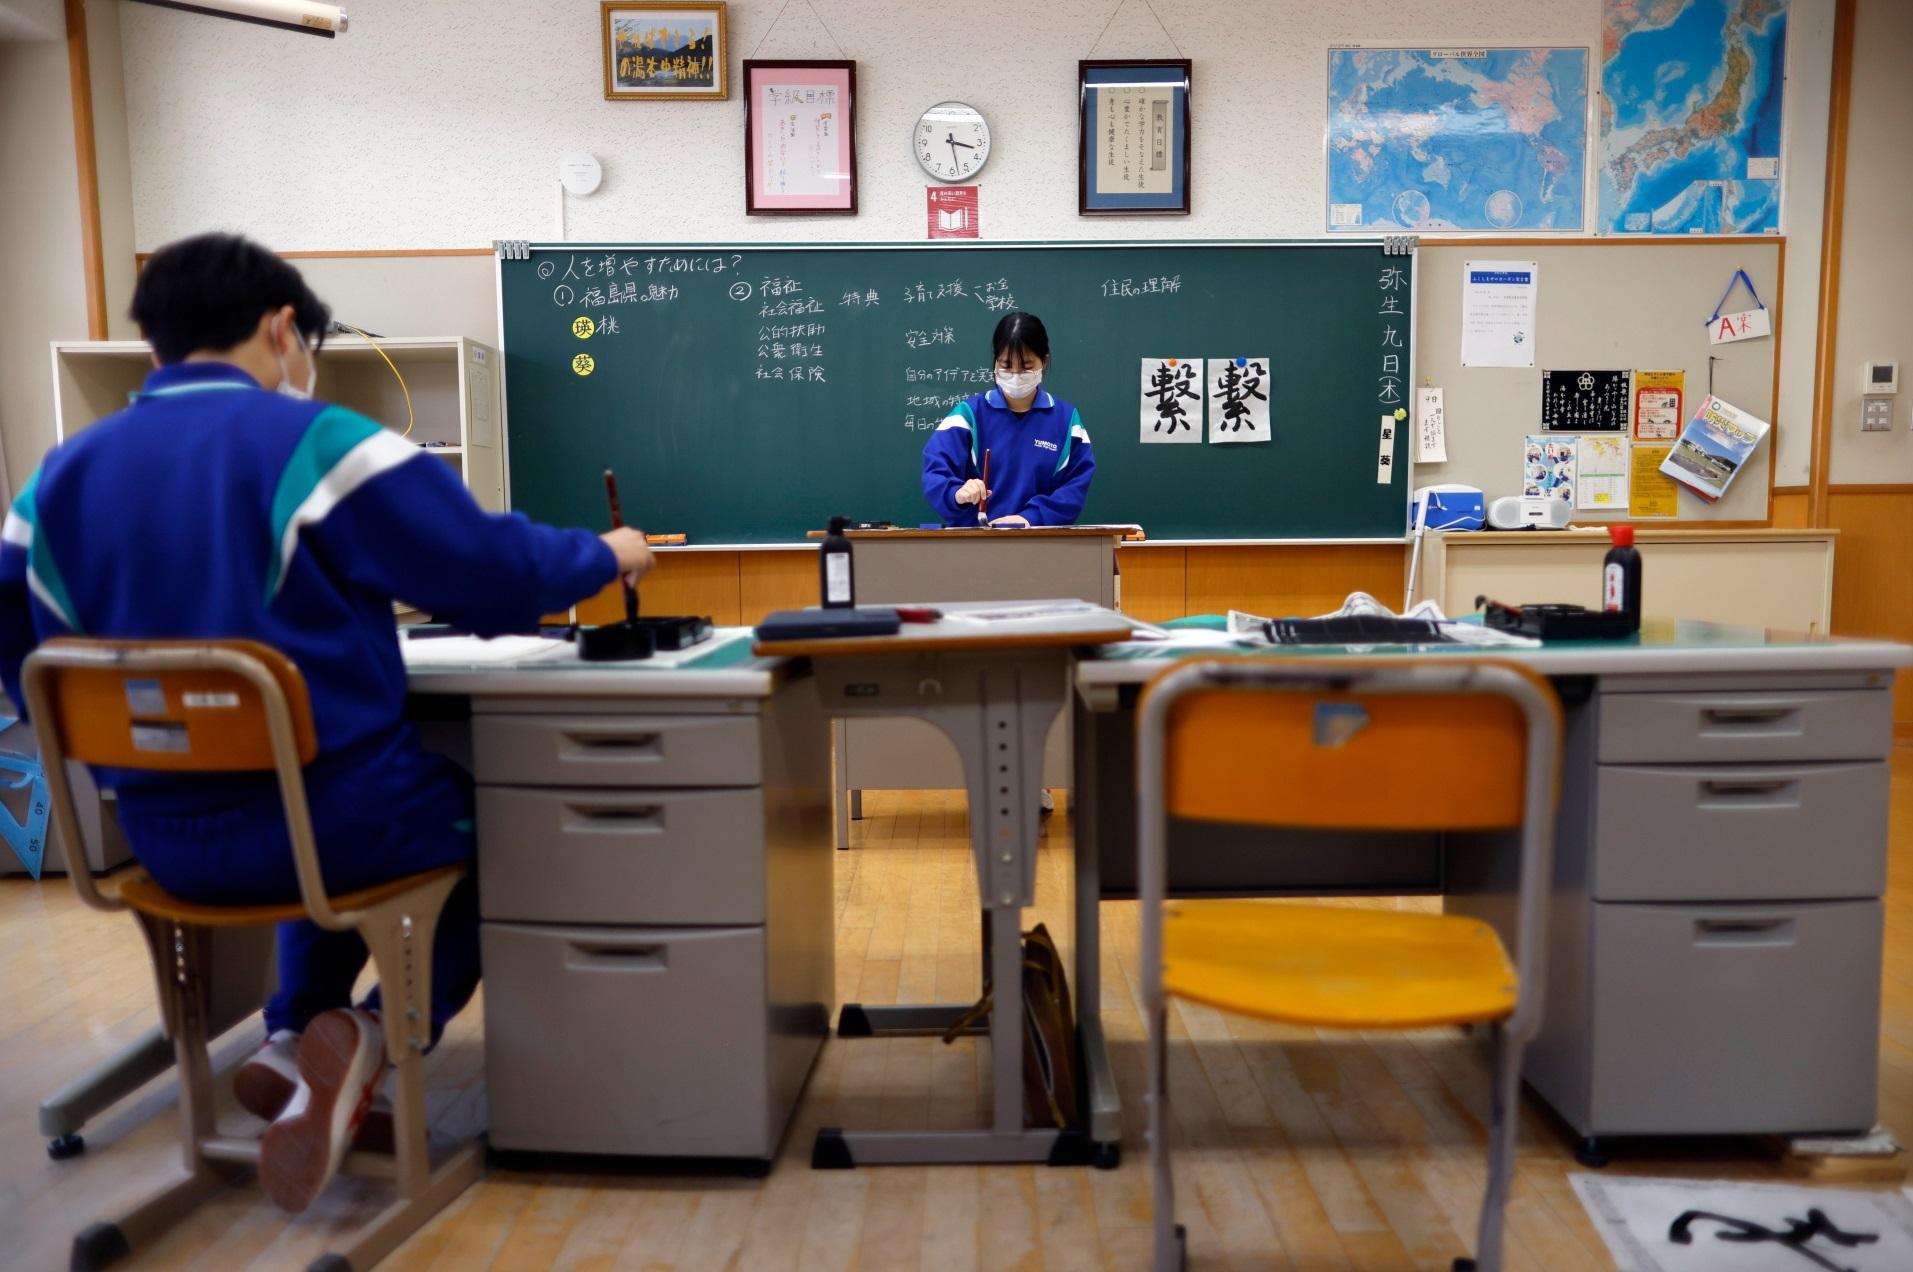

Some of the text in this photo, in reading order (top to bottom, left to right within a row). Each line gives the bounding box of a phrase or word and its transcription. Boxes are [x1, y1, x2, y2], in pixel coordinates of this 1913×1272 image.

[769, 88, 835, 106] 学級目標
[925, 125, 932, 133] 10
[922, 139, 927, 147] 9
[925, 153, 931, 161] 8
[936, 163, 941, 171] 7
[950, 167, 955, 175] 6
[964, 163, 969, 171] 5
[930, 191, 938, 202] 4
[759, 276, 803, 297] 福祉
[904, 278, 968, 303] 子育て支援
[986, 278, 1009, 292] お金
[1101, 274, 1182, 297] 住民の理解
[579, 282, 679, 308] 福島県の魅力
[842, 288, 880, 307] 特典
[986, 293, 1019, 311] 学校
[758, 297, 825, 318] 社会福祉
[596, 315, 620, 334] 桃
[758, 323, 826, 341] 公的扶助
[905, 325, 956, 349] 安全対策
[757, 343, 825, 359] 公衆衛生
[574, 356, 592, 374] 葵
[754, 364, 827, 383] 社会保険
[1034, 439, 1058, 449] YUMOTO
